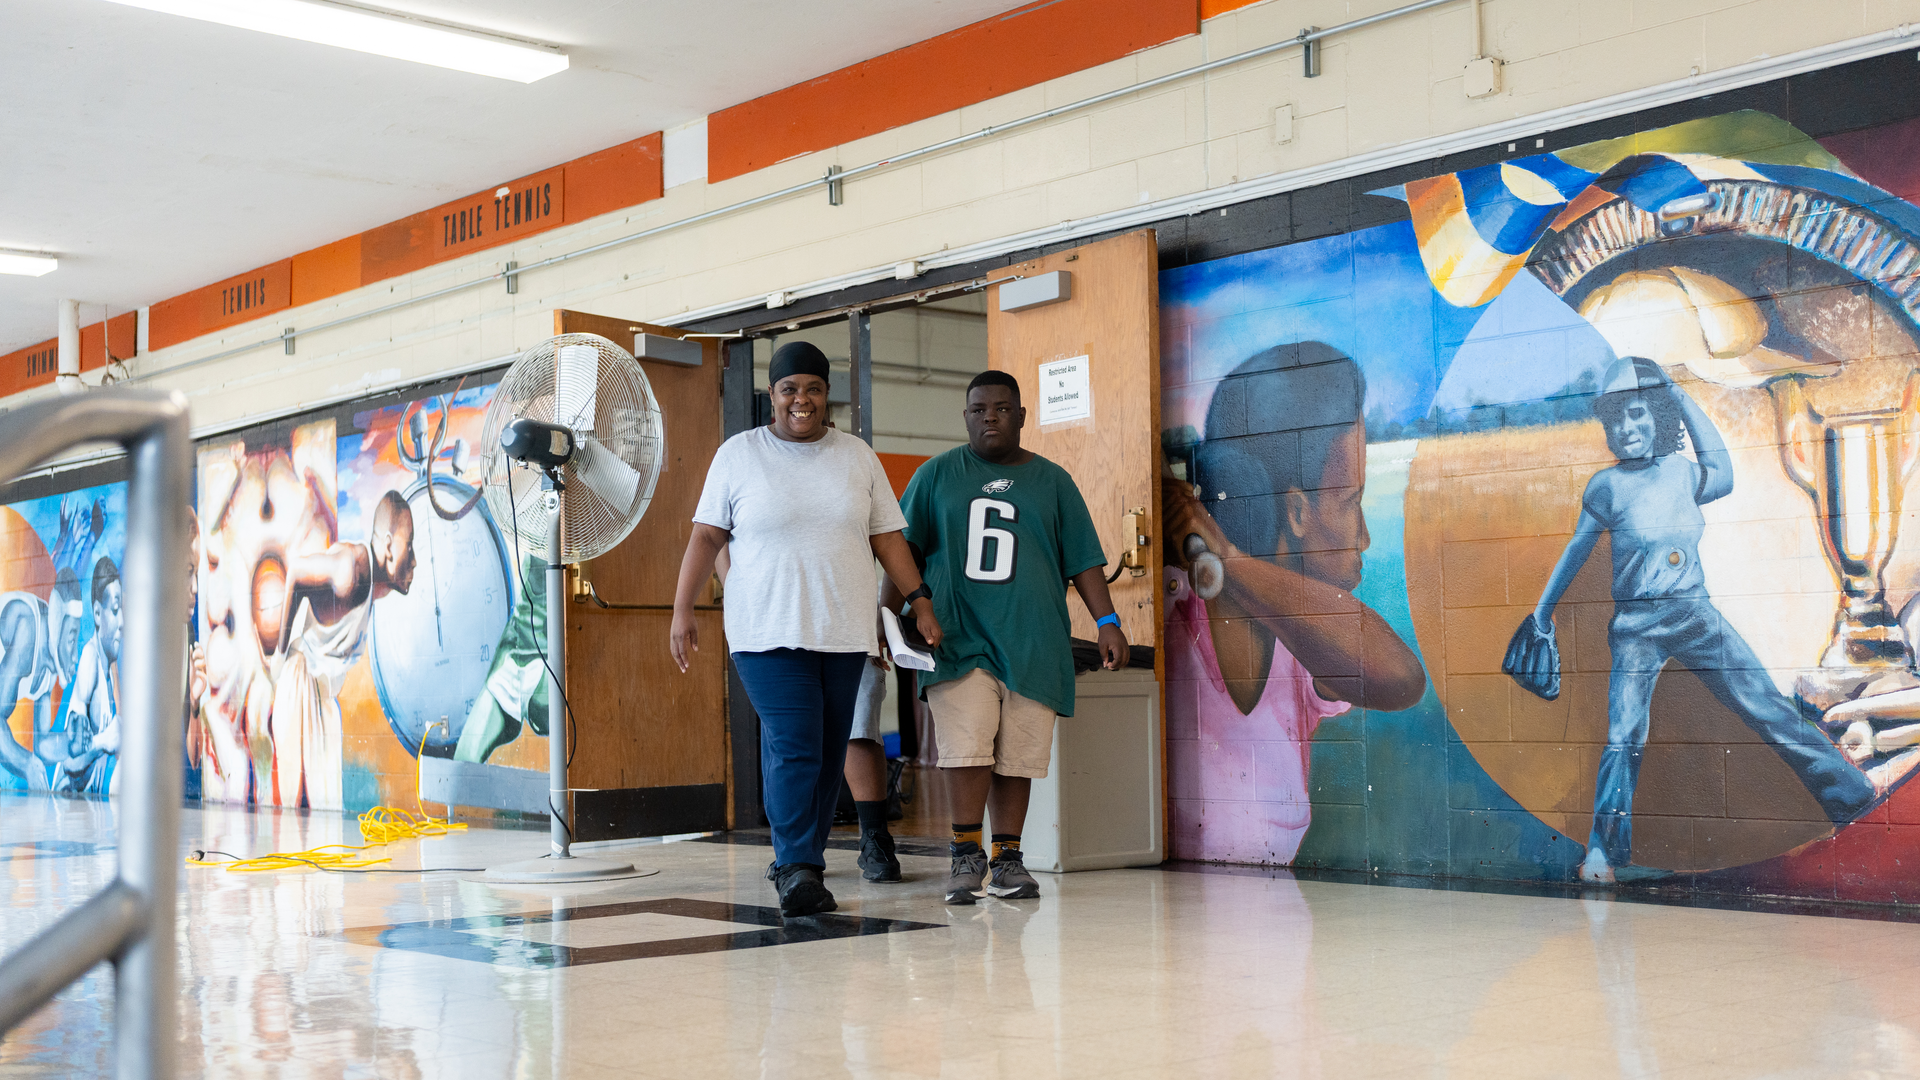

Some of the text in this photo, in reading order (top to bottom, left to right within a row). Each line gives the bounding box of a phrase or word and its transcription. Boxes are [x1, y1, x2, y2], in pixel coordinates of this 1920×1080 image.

[443, 183, 550, 247] TABLE TENNIS
[222, 278, 265, 316] TENNIS
[27, 347, 59, 378] SWIMMI
[1048, 366, 1067, 376] Restricted
[1058, 380, 1065, 388] No
[1047, 391, 1079, 404] Students Allowed
[963, 496, 1019, 585] 6
[480, 643, 490, 662] 20
